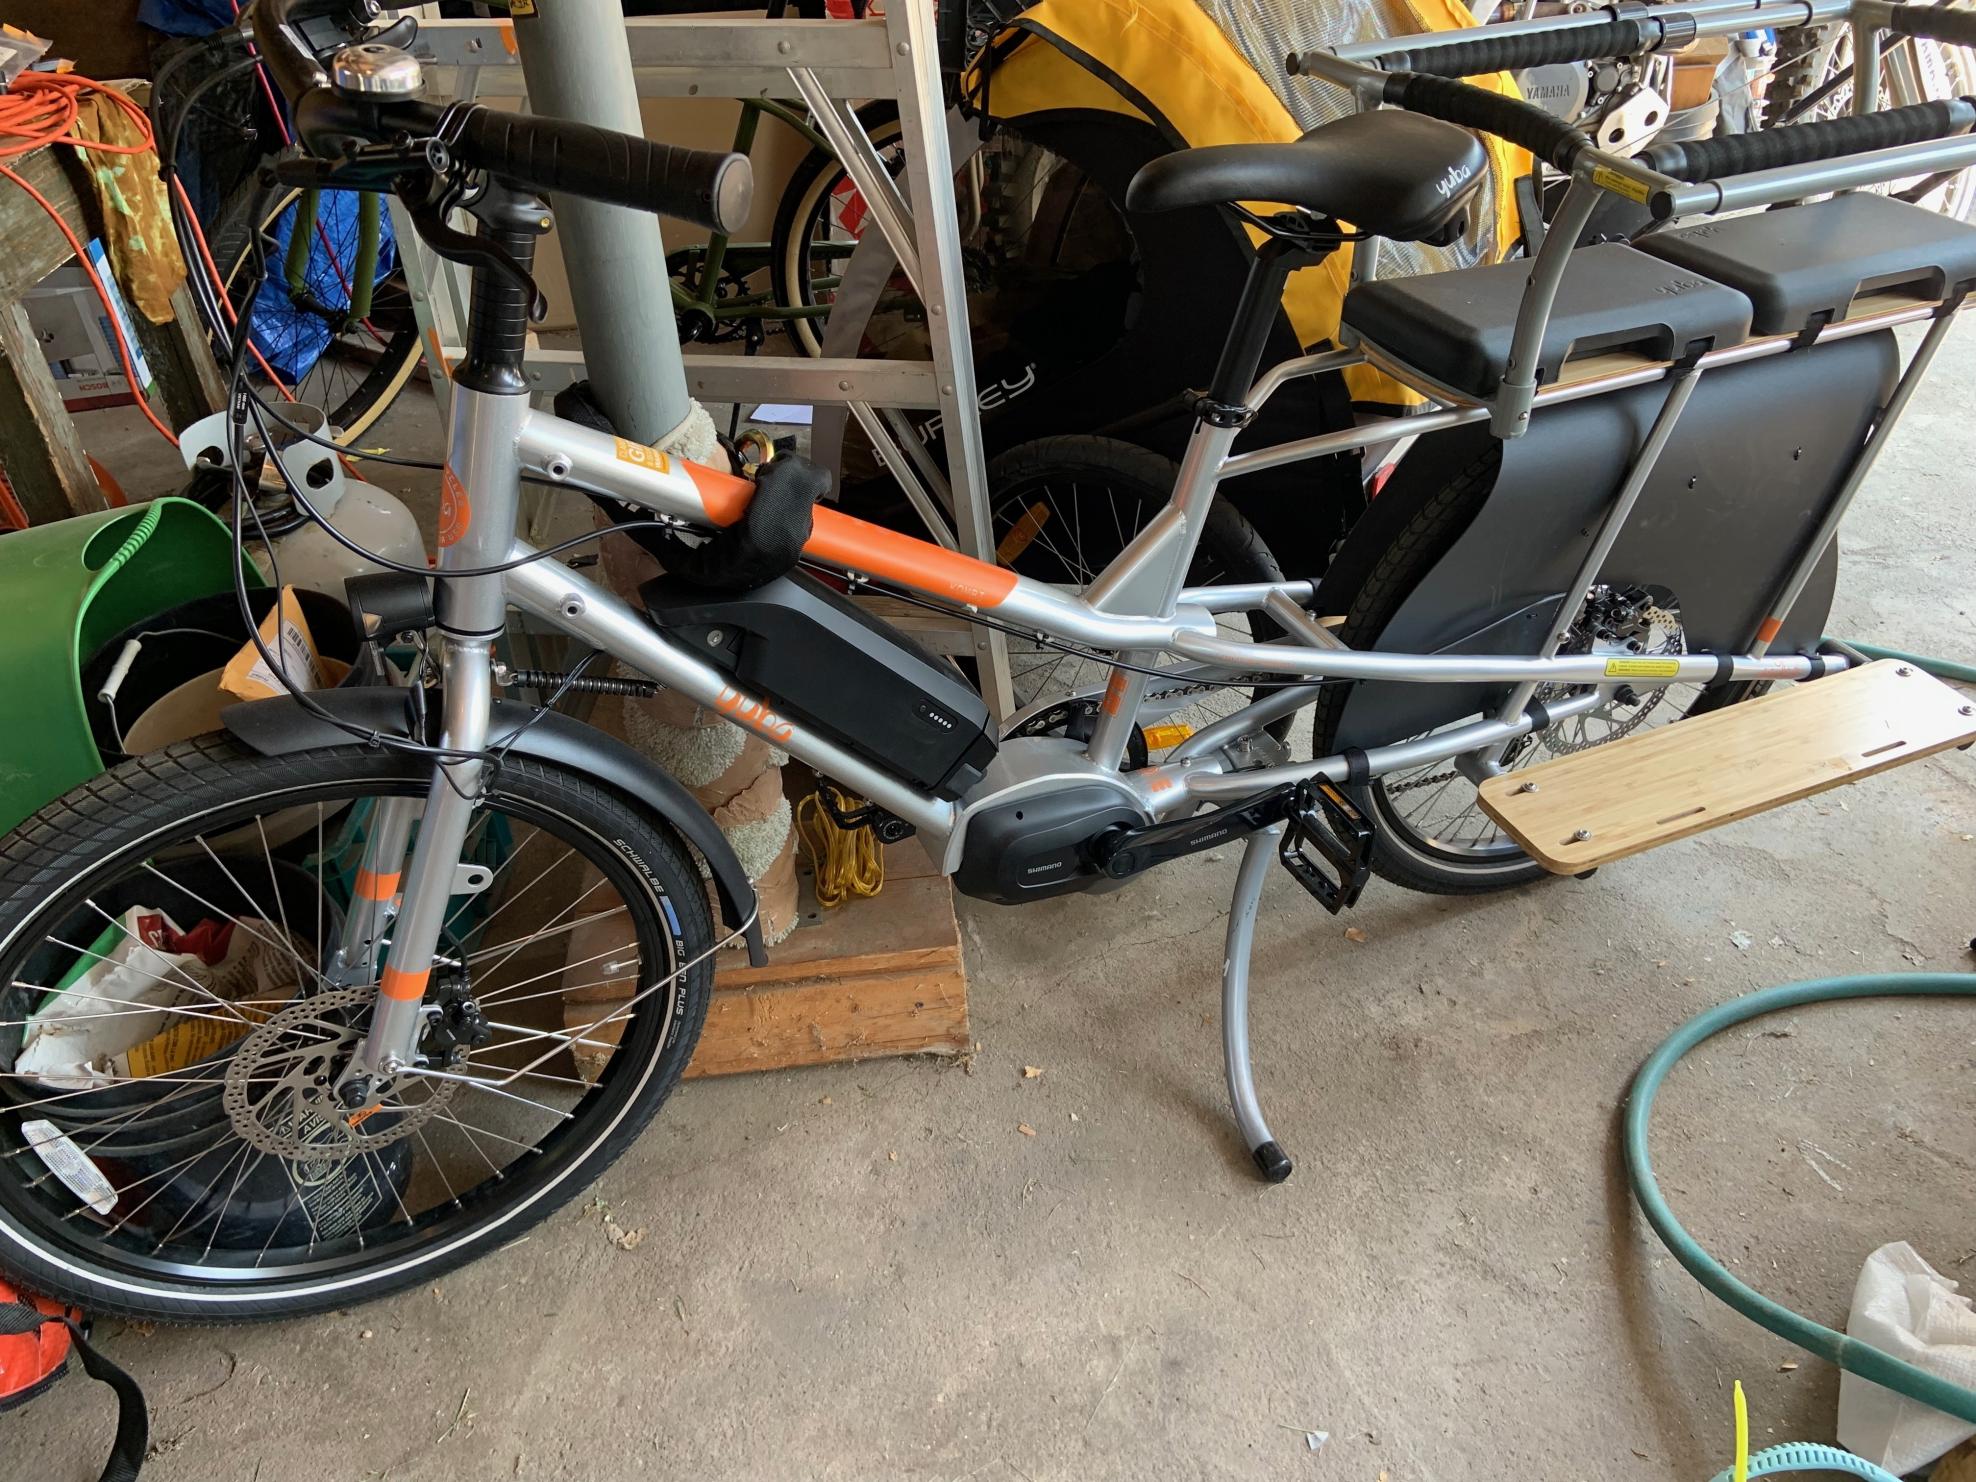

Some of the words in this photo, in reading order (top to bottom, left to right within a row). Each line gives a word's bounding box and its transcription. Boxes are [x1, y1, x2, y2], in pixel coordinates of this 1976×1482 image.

[1527, 84, 1570, 99] YAMAHA
[1435, 165, 1471, 199] yuba
[715, 686, 793, 743] yuba
[1190, 828, 1228, 846] SHIMANO
[612, 838, 664, 893] SCHWALBE
[1027, 861, 1062, 874] SHIMANO
[675, 939, 686, 957] BIG
[676, 987, 687, 1015] PLUS
